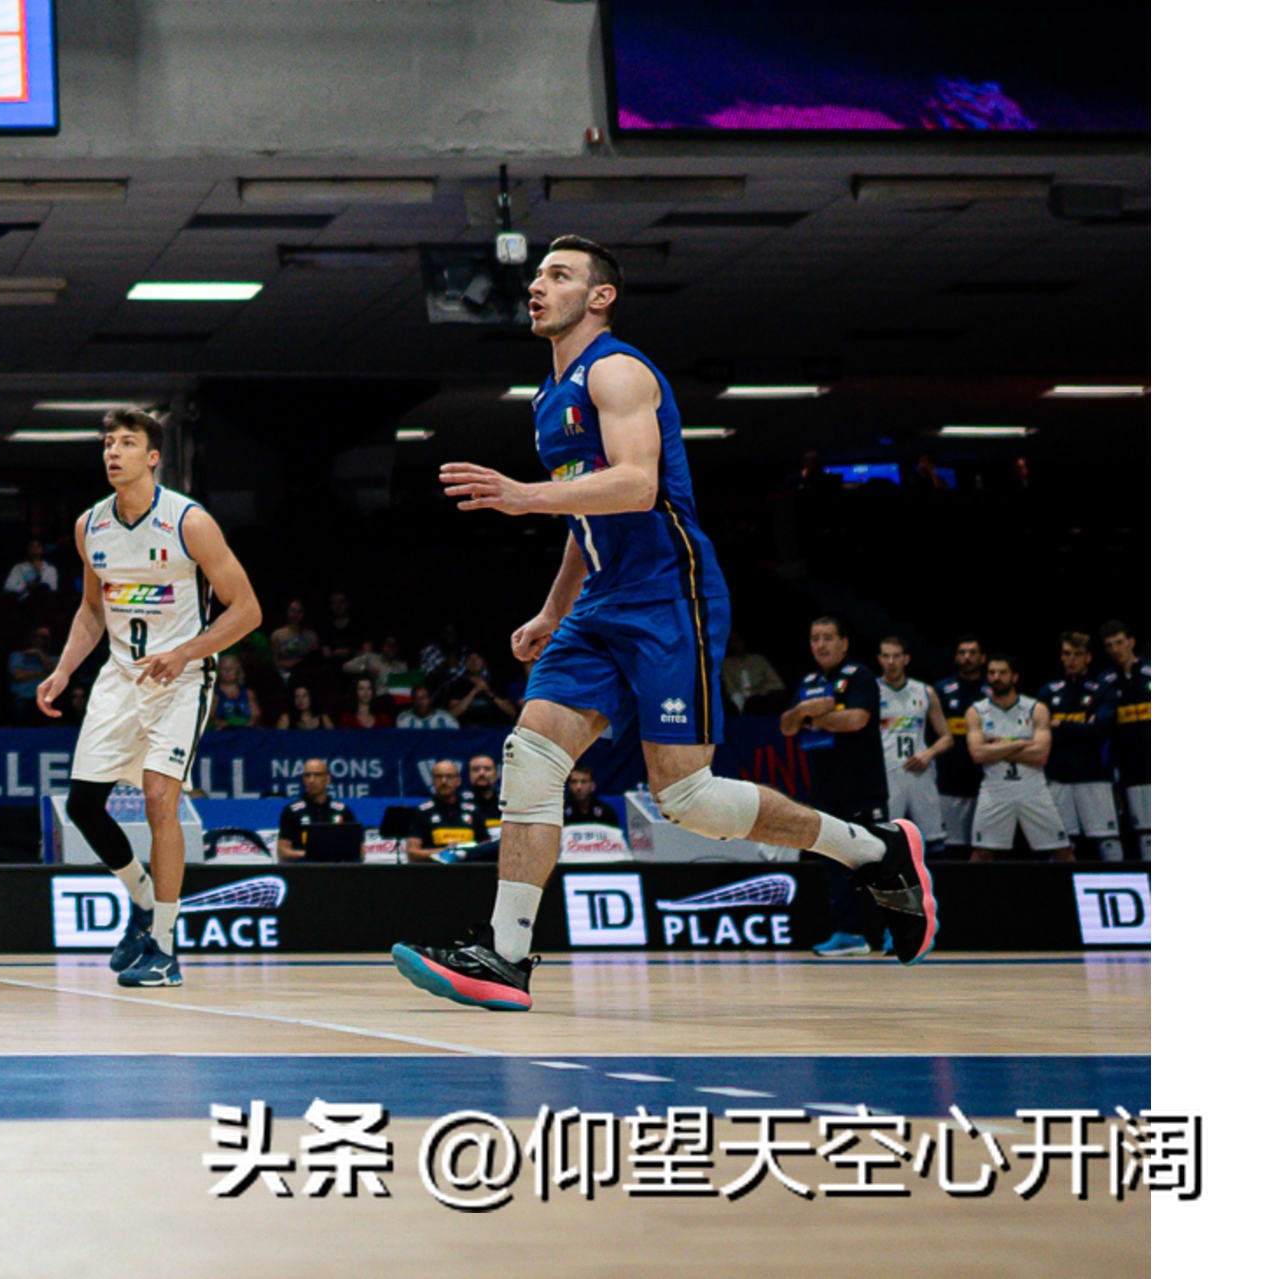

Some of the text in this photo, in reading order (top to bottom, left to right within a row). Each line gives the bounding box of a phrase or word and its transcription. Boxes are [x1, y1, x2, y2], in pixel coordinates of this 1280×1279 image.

[563, 424, 585, 437] ITA
[129, 617, 148, 662] 9
[896, 732, 915, 759] 13
[270, 757, 384, 779] NAONS
[61, 891, 122, 933] TD
[574, 888, 634, 930] TD
[1084, 888, 1145, 929] TD
[176, 916, 281, 948] LACE
[663, 915, 792, 947] PLACE
